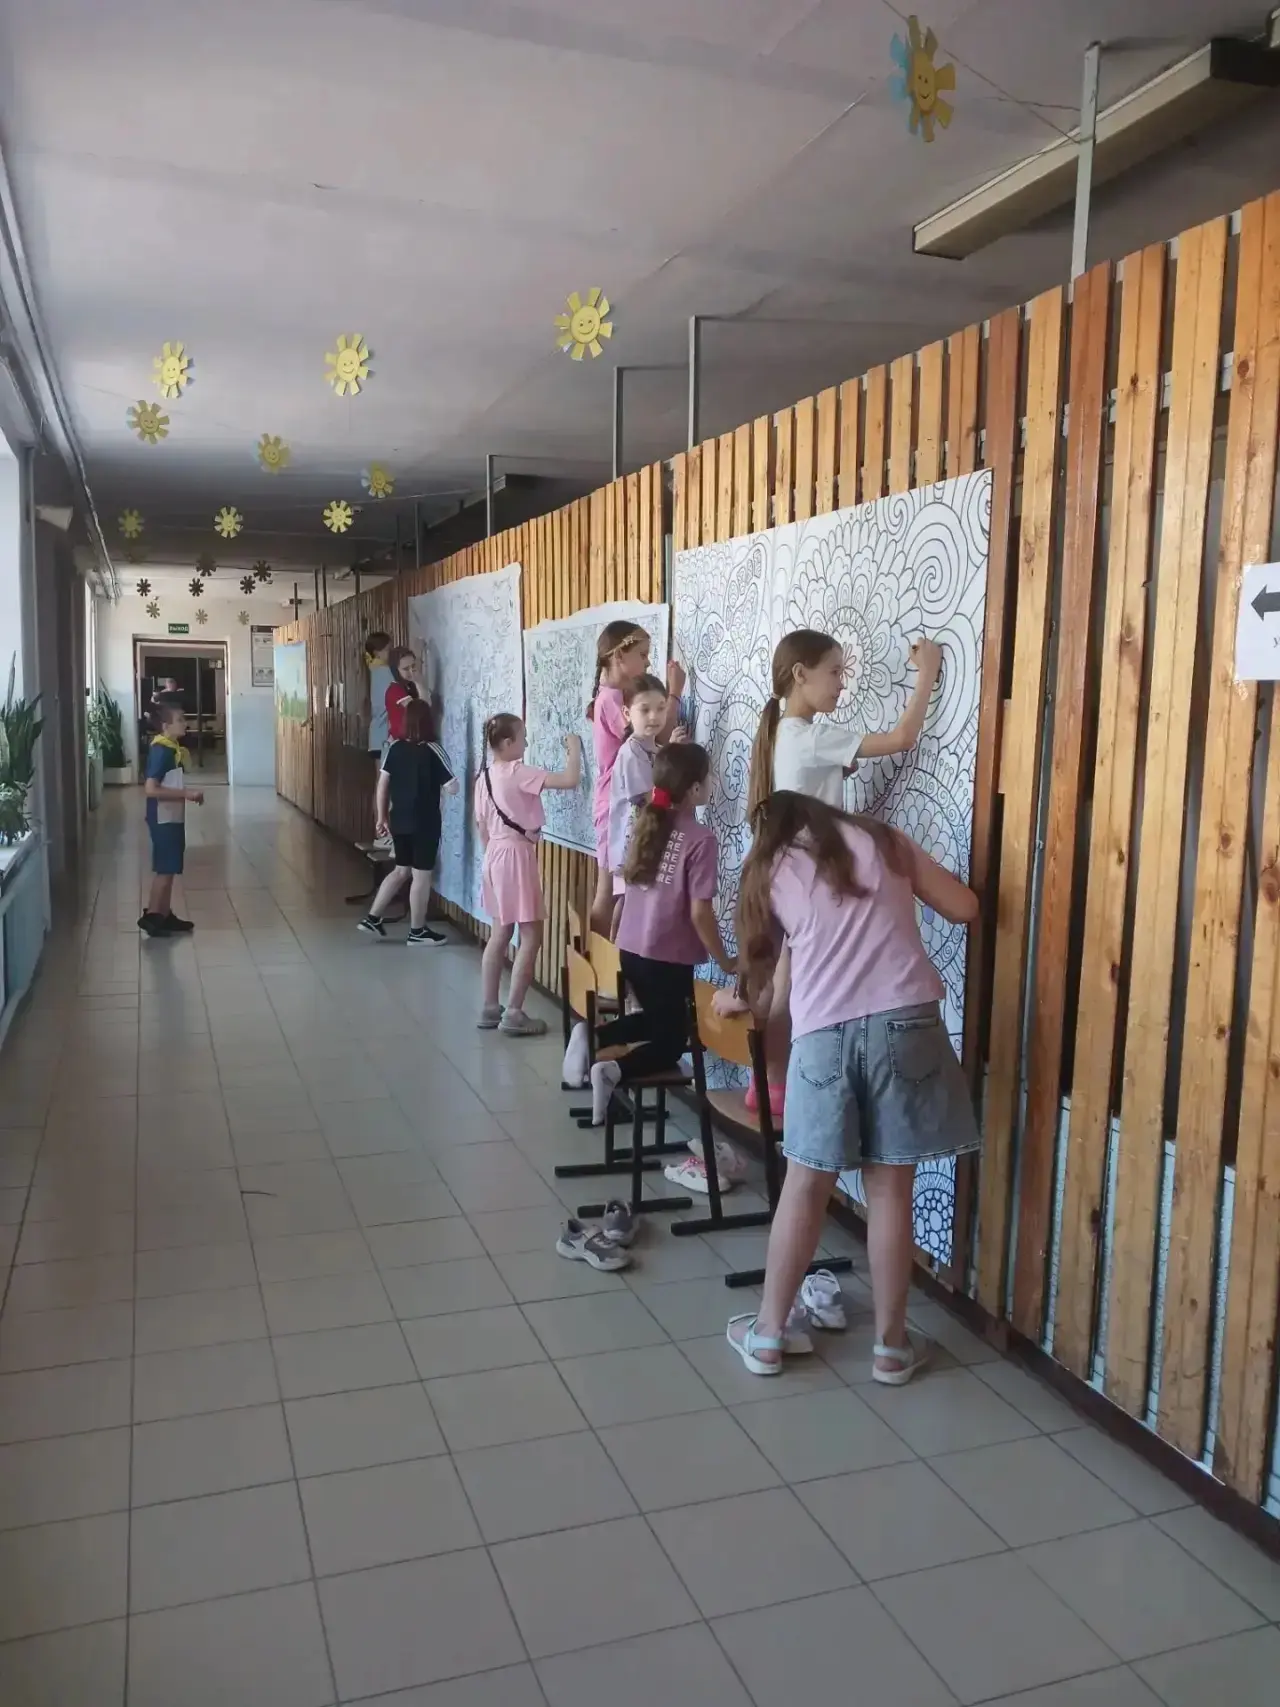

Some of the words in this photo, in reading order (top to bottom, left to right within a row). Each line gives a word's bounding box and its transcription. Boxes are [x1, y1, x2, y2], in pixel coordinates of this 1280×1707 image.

[671, 830, 685, 841] RE
[667, 840, 681, 851] RE
[664, 851, 679, 862] RE
[661, 862, 675, 873] RE
[657, 873, 672, 884] RE
